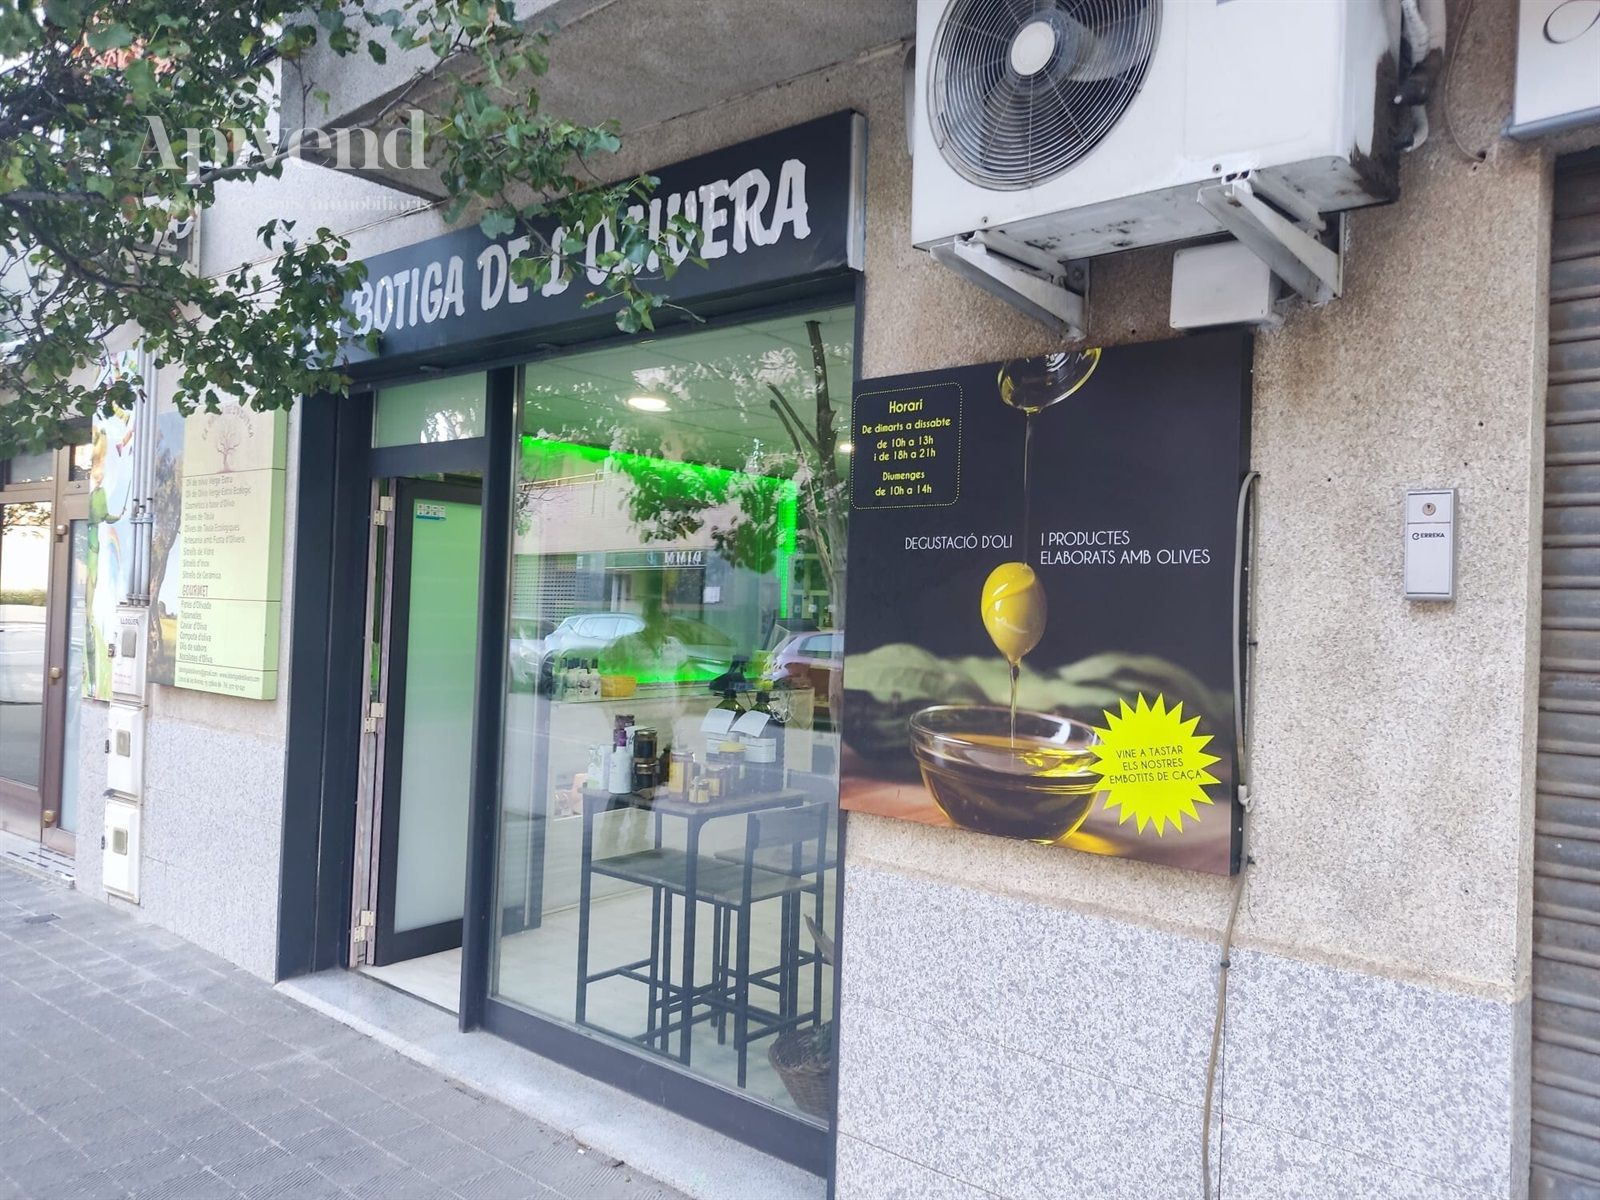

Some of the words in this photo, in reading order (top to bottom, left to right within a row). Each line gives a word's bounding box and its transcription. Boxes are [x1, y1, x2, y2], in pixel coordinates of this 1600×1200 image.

[351, 255, 465, 336] BOTIGA
[477, 235, 531, 311] DE
[889, 398, 923, 413] Horari
[862, 425, 872, 434] De
[874, 422, 903, 433] dimarts
[914, 417, 951, 429] dissabte
[877, 440, 887, 449] de
[892, 438, 905, 448] 10h
[919, 435, 934, 446] 13h
[879, 452, 889, 461] de
[894, 450, 908, 460] 18h
[919, 448, 936, 458] 21h
[883, 471, 925, 481] Diumenges
[875, 487, 886, 496] de
[890, 485, 904, 496] 10h
[907, 487, 912, 495] a
[917, 484, 932, 494] 14h
[905, 533, 978, 550] DEGUSTACIÓ
[981, 534, 1013, 549] D'OLI
[1040, 532, 1045, 546] I
[1048, 530, 1130, 546] PRODUCTES
[1040, 550, 1116, 565] ELABORATS
[1120, 549, 1151, 565] AMB
[1156, 549, 1211, 565] OLIVES
[1116, 749, 1136, 759] VINE
[1140, 749, 1146, 757] A
[1149, 745, 1183, 757] TASTAR
[1122, 761, 1138, 771] ELS
[1141, 758, 1184, 769] NOSTRES
[1109, 773, 1154, 784] EMBOTITS
[1157, 771, 1169, 781] DE
[1172, 769, 1202, 781] CAÇA
